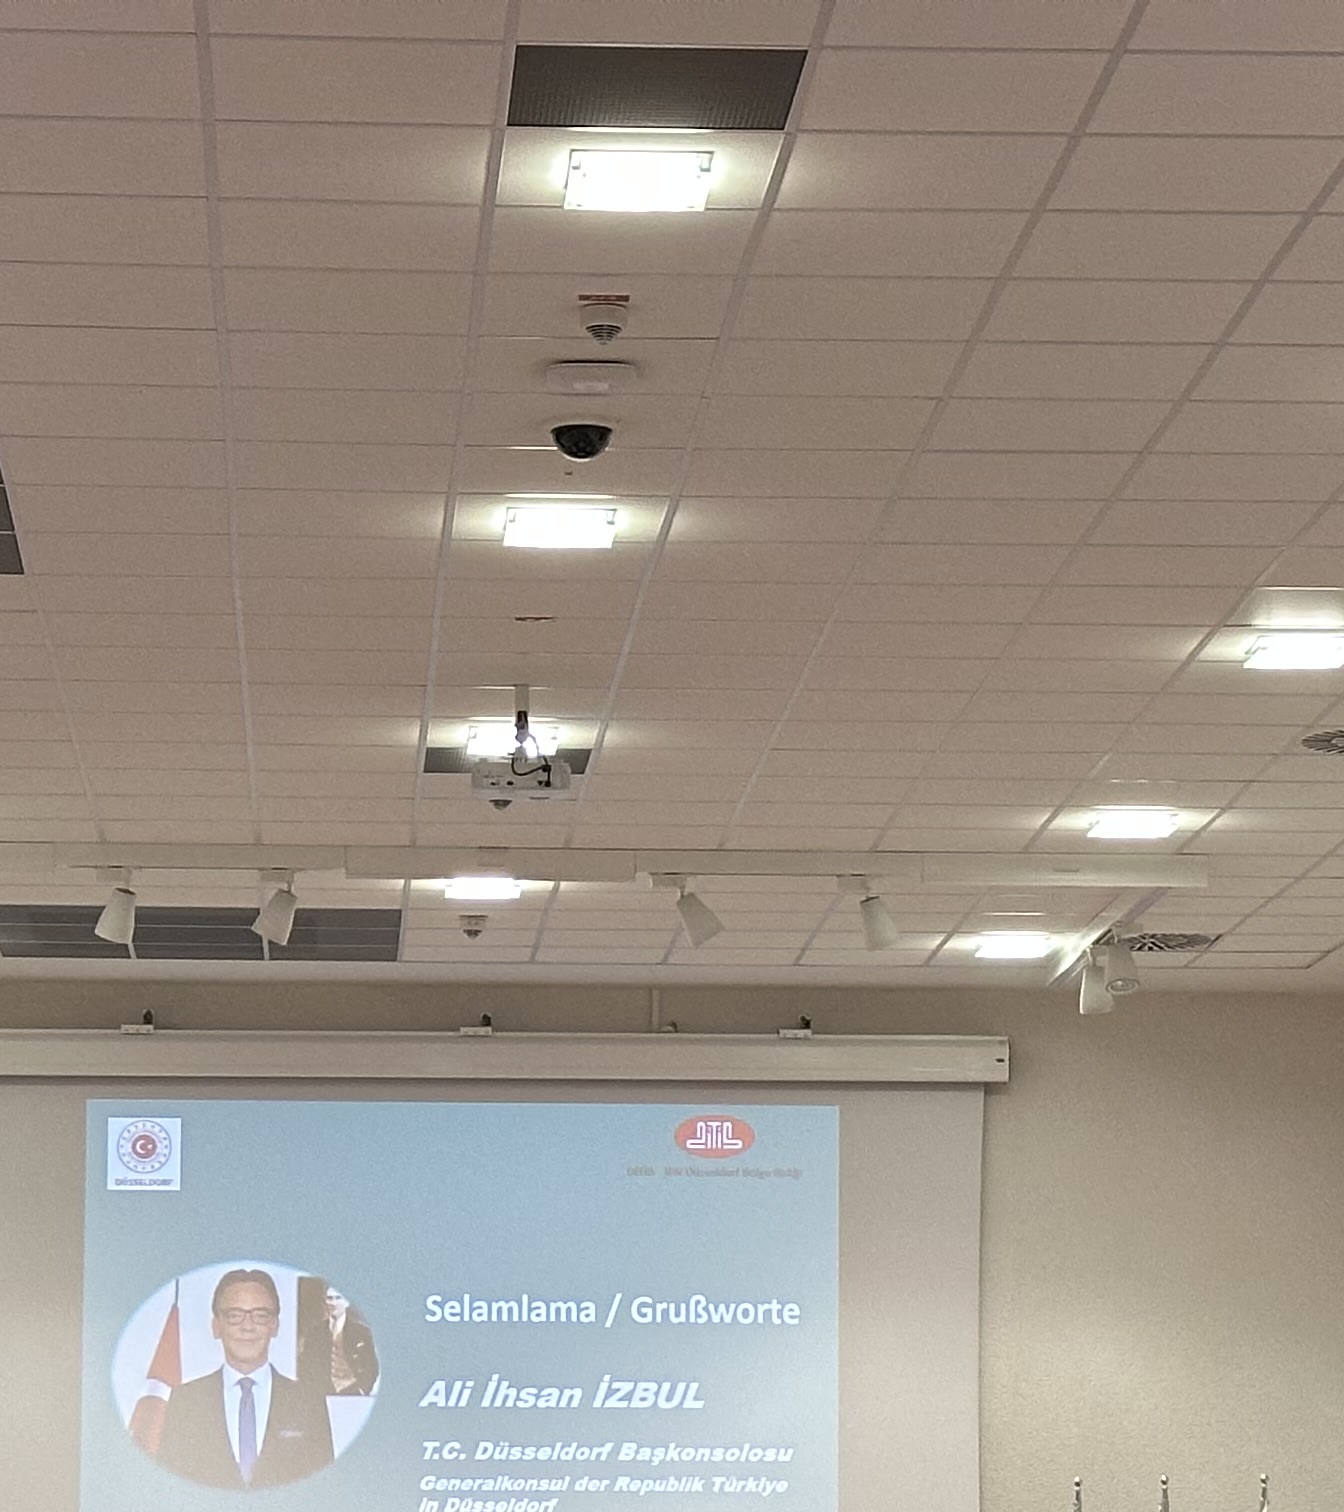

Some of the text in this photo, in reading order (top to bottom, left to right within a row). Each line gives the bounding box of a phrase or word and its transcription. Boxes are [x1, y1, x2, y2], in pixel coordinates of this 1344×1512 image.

[424, 1293, 801, 1328] Selamlama / Grußworte
[419, 1374, 705, 1409] Ali İhsan İZBUL
[421, 1441, 795, 1466] T.C. Düsseldorf Başkonsolosu
[419, 1475, 789, 1497] Generalkonsul der Republik Türkiye
